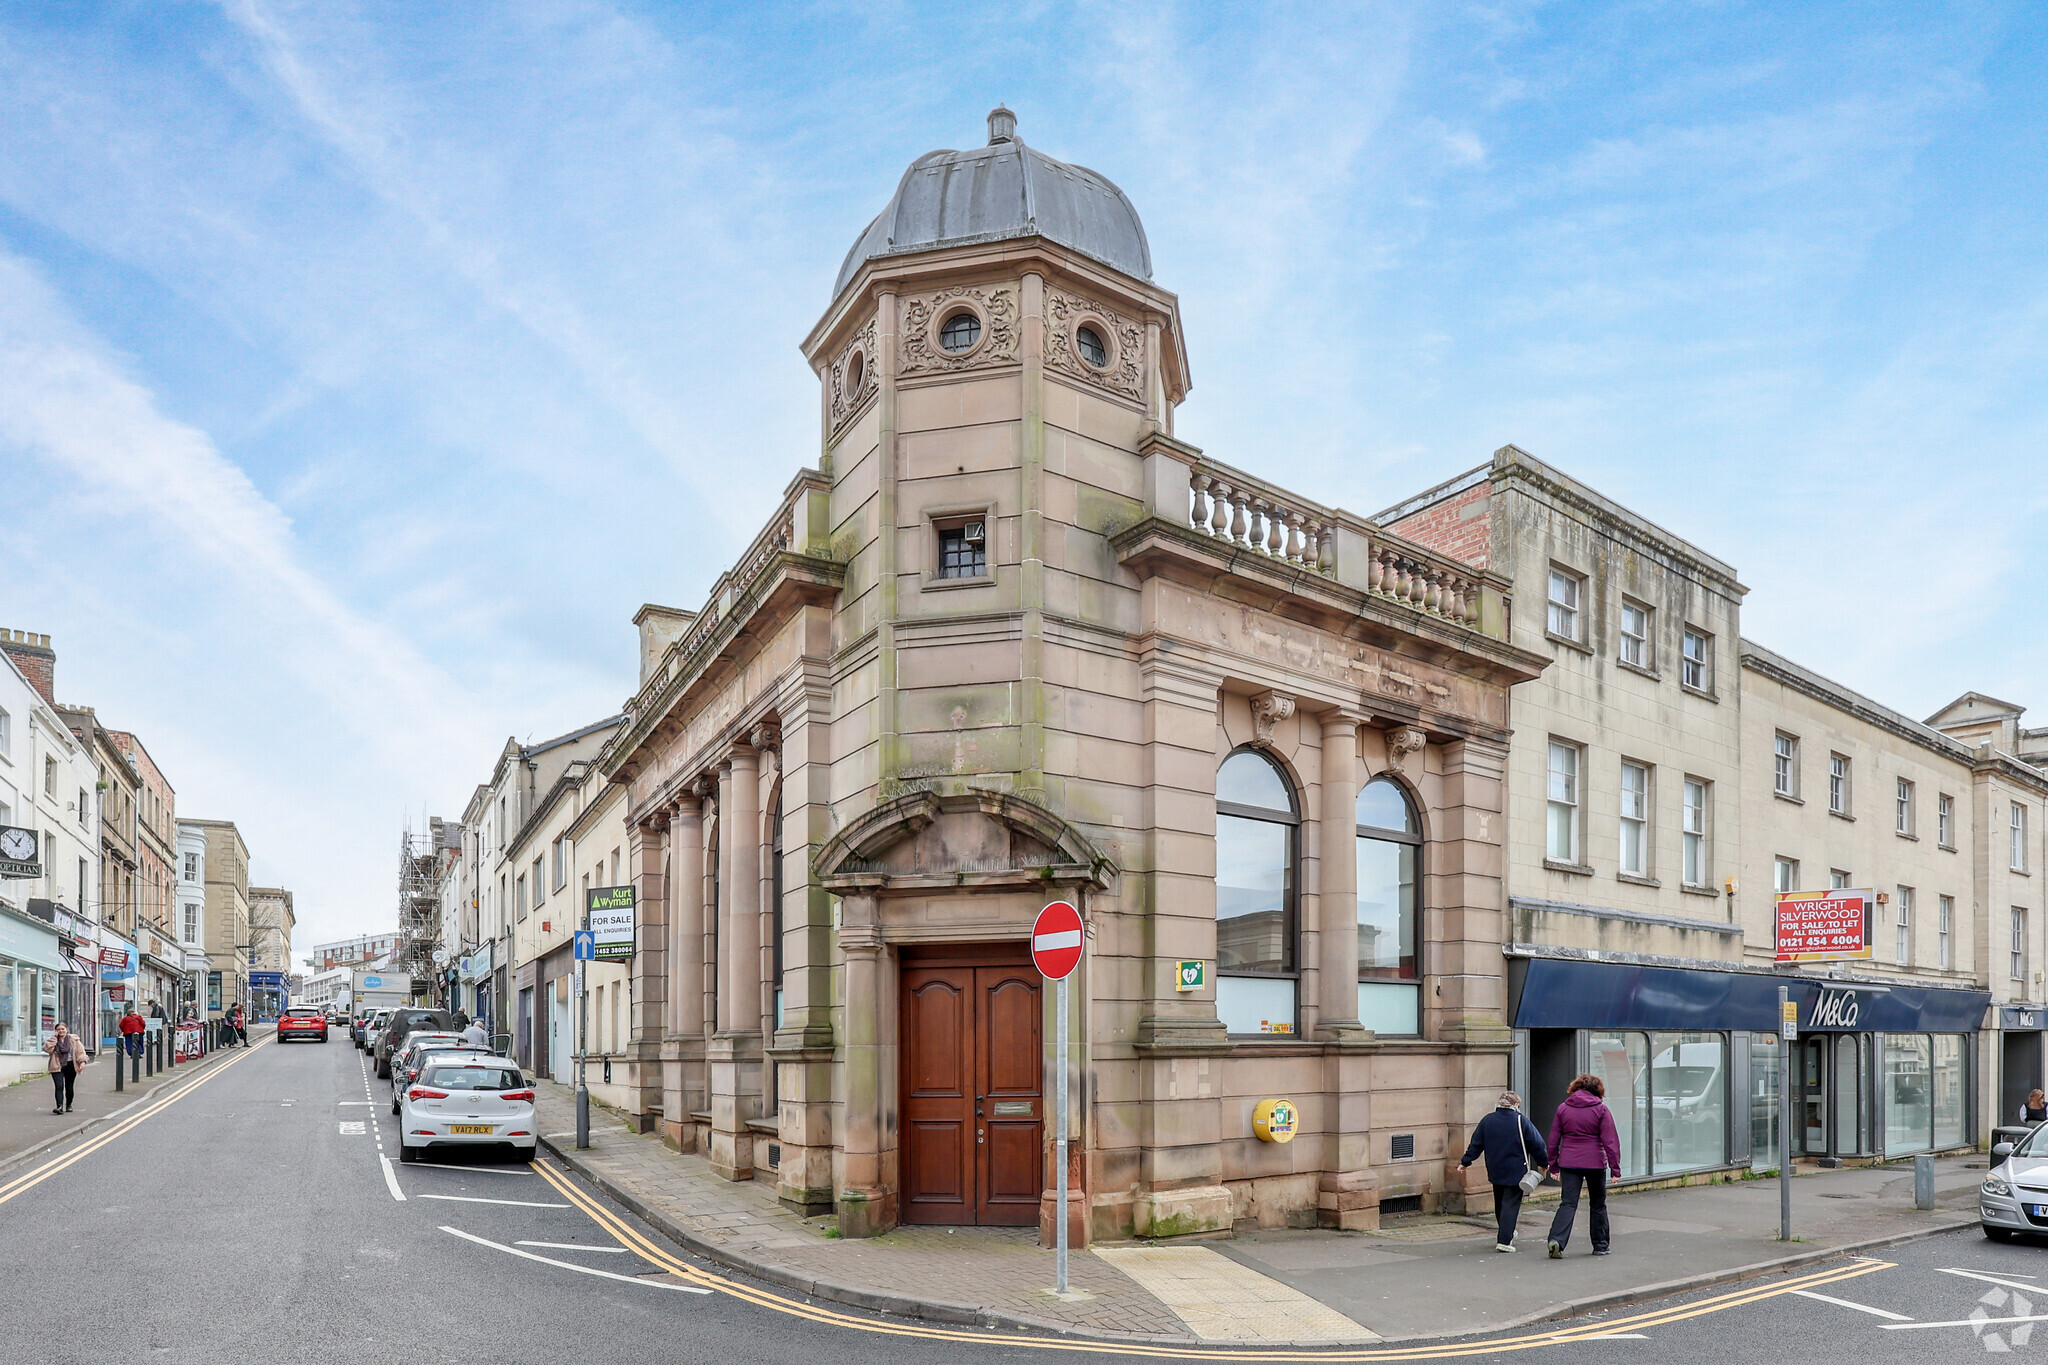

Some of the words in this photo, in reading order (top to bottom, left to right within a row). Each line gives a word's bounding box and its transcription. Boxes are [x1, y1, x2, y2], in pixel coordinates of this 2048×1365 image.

[0, 863, 39, 874] OPTICIAN
[612, 889, 632, 898] Kurt
[600, 897, 632, 908] Wyman
[1793, 900, 1847, 911] WRIGHT
[592, 917, 608, 925] FOR
[610, 915, 632, 924] SALE
[1780, 909, 1861, 922] SILVERWOOD
[1781, 922, 1799, 930] FOR
[1801, 920, 1841, 929] SALE/TO
[1843, 920, 1859, 928] LET
[1808, 928, 1847, 936] ENQUIRIES
[1779, 937, 1803, 947] 0121
[1806, 936, 1828, 946] 454
[1831, 935, 1861, 945] 4004
